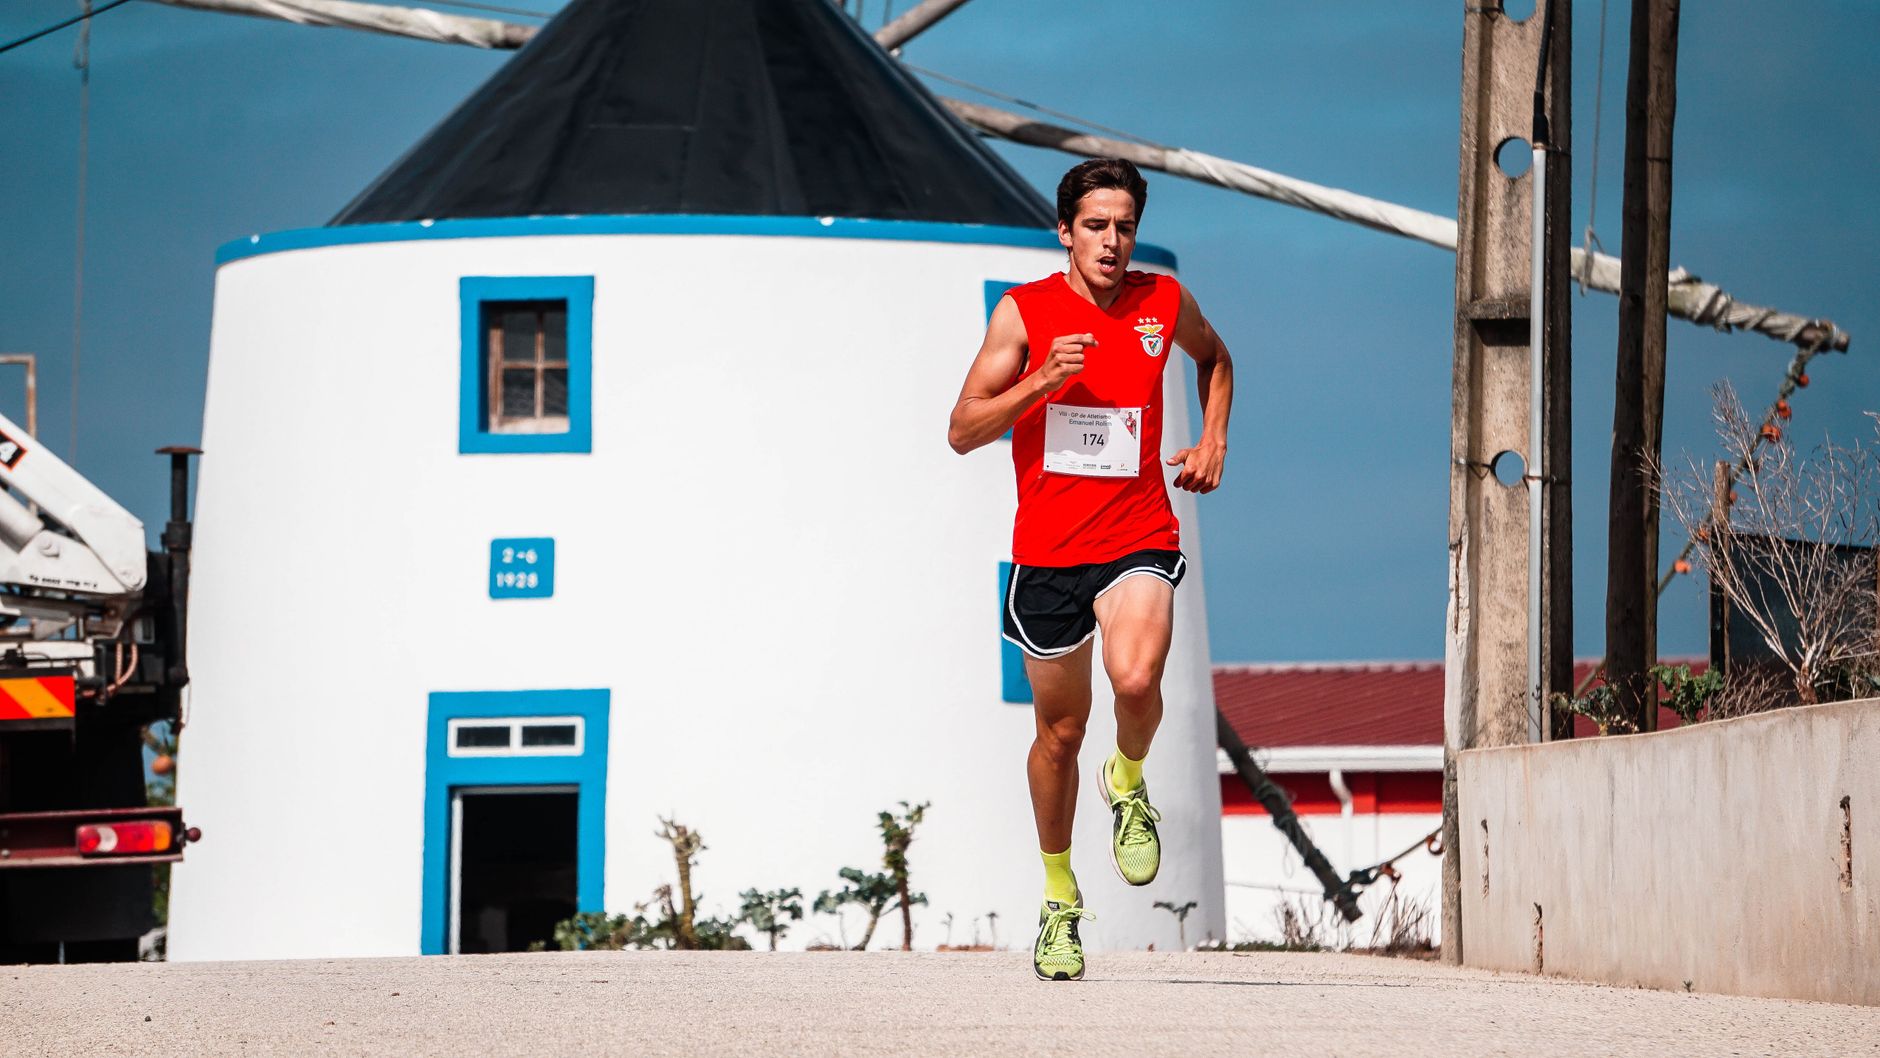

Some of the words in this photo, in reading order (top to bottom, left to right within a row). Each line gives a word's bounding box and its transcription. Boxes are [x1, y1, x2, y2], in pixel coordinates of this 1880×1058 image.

[1082, 433, 1105, 446] 174
[502, 547, 538, 564] 2-6
[496, 572, 539, 589] 1928
